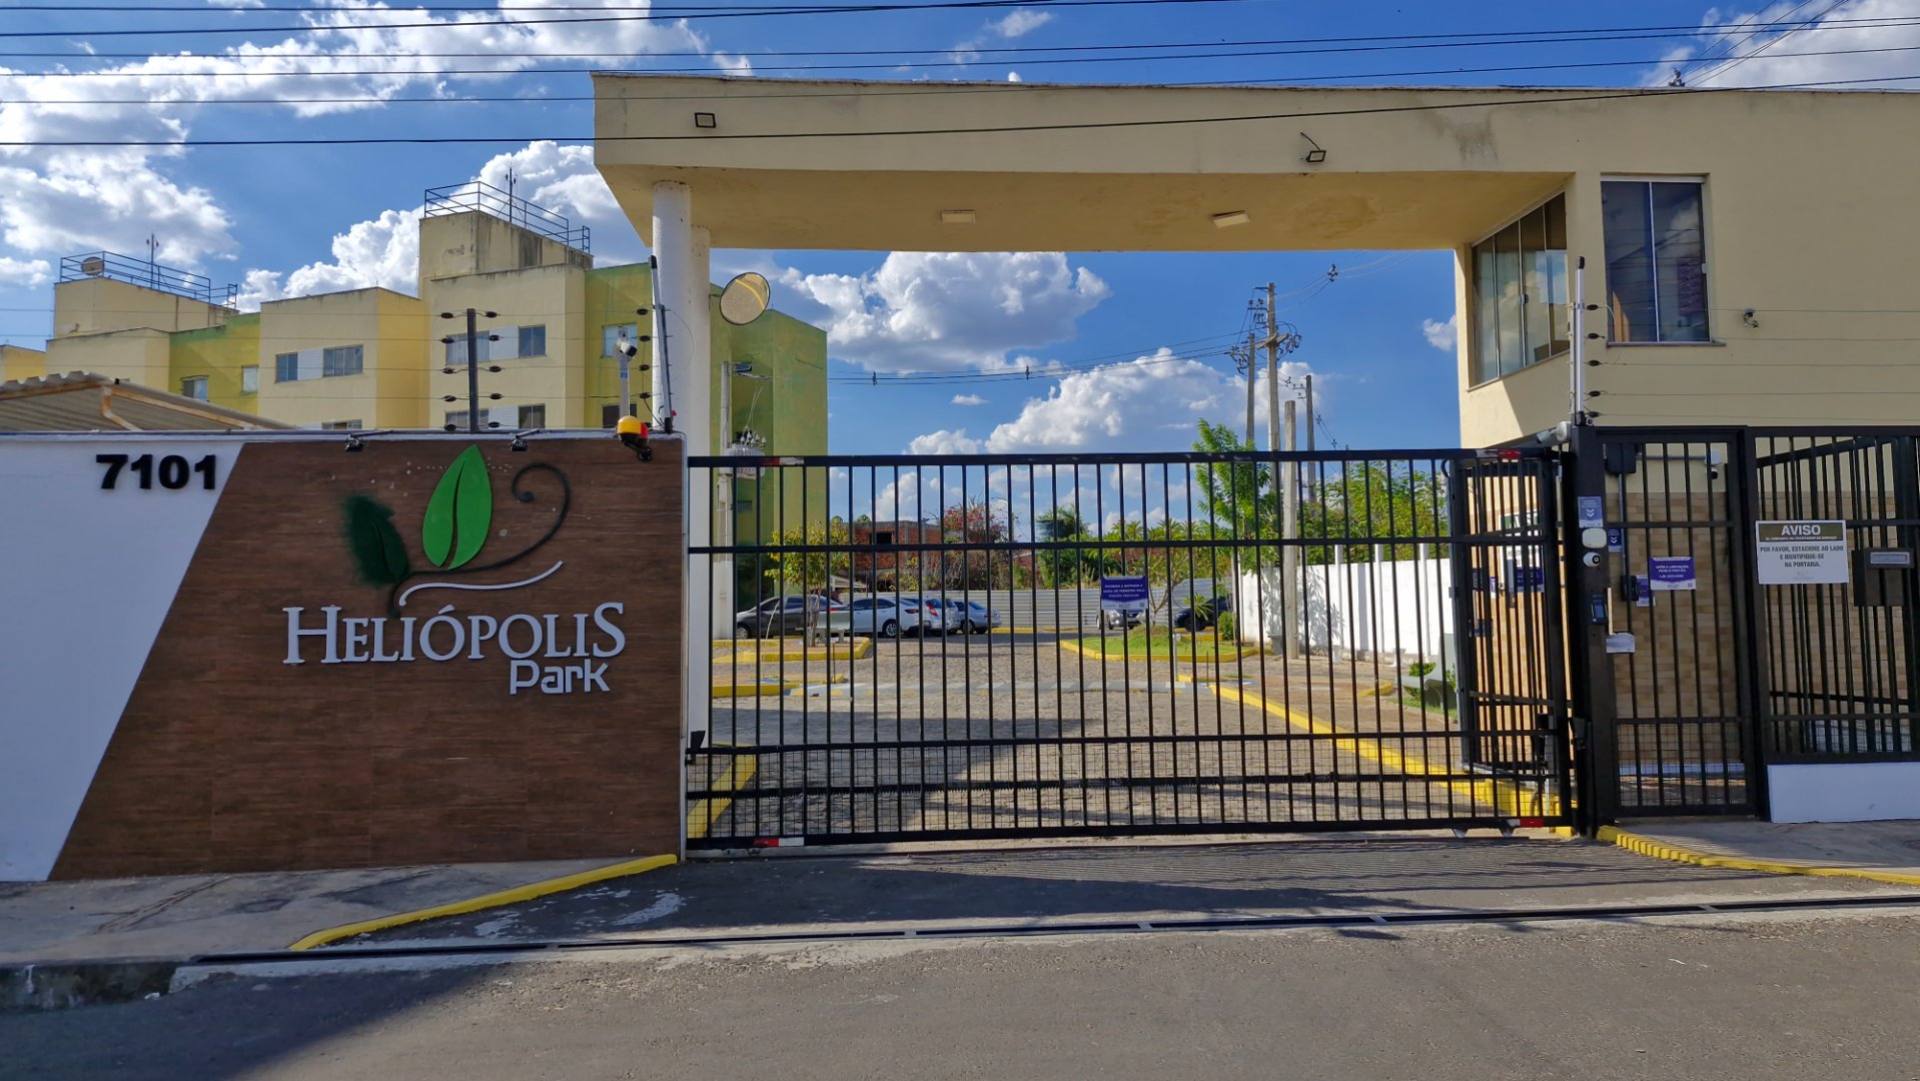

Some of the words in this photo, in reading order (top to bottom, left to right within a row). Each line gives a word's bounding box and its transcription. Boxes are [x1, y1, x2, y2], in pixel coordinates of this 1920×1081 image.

[95, 454, 217, 490] 7101
[1781, 524, 1821, 536] AVISO
[282, 602, 626, 665] HELIÓPOLIS
[509, 658, 611, 696] Park
